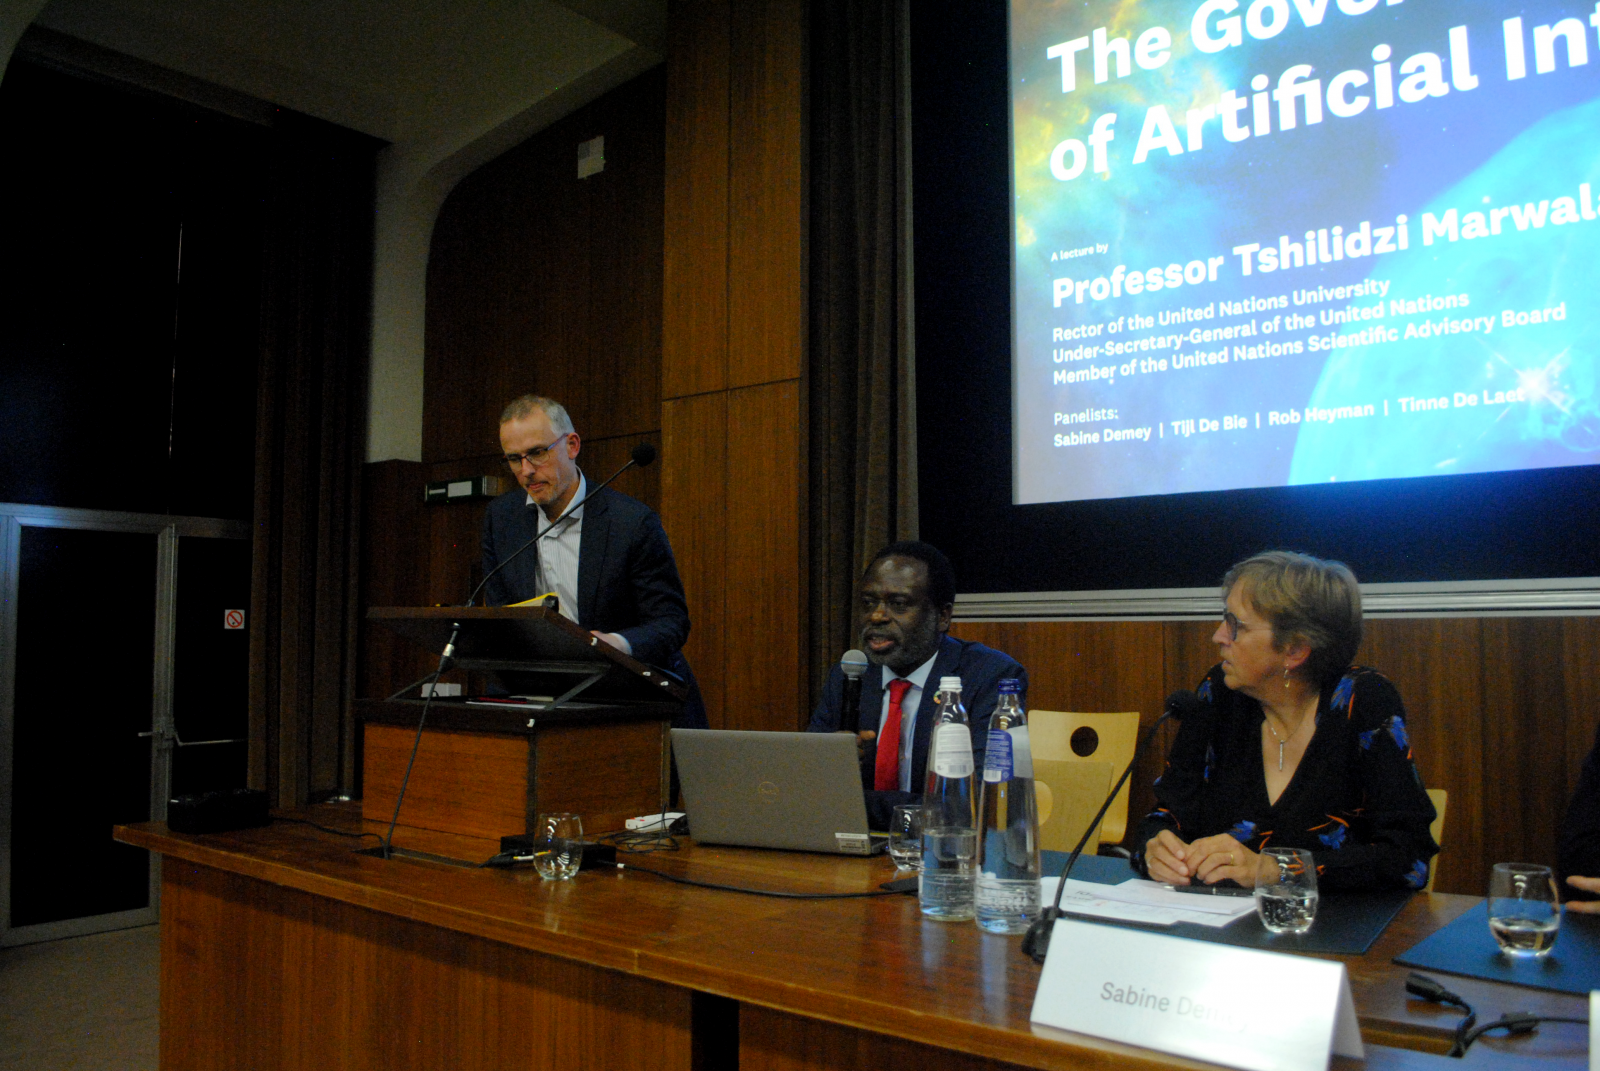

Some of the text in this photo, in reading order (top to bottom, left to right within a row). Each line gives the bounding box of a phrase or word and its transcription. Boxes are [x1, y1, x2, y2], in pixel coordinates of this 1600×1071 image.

[1048, 26, 1174, 92] The
[1050, 113, 1117, 180] of
[1131, 26, 1478, 164] Artificial
[1051, 243, 1109, 262] A lecture by
[1052, 183, 1600, 307] Professor Tshilidzi Marwal
[1053, 294, 1470, 363] Under-Secretary-General of the United Nations
[1054, 279, 1390, 342] Rector of the United Nations University
[1054, 302, 1566, 384] Member of the United Nations Scientific Advisory Board
[1055, 408, 1119, 425] Panelists:
[1055, 431, 1100, 446] Sabine
[1104, 428, 1152, 441] Demey
[1172, 419, 1195, 437] Tijl
[1200, 419, 1219, 432] De
[1224, 415, 1248, 430] Bie
[1269, 409, 1301, 425] Rob
[1305, 404, 1374, 424] Heyman
[1398, 397, 1449, 412] Tinne
[1454, 392, 1478, 407] De
[1483, 387, 1526, 405] Laet
[1100, 981, 1171, 1012] Sabine
